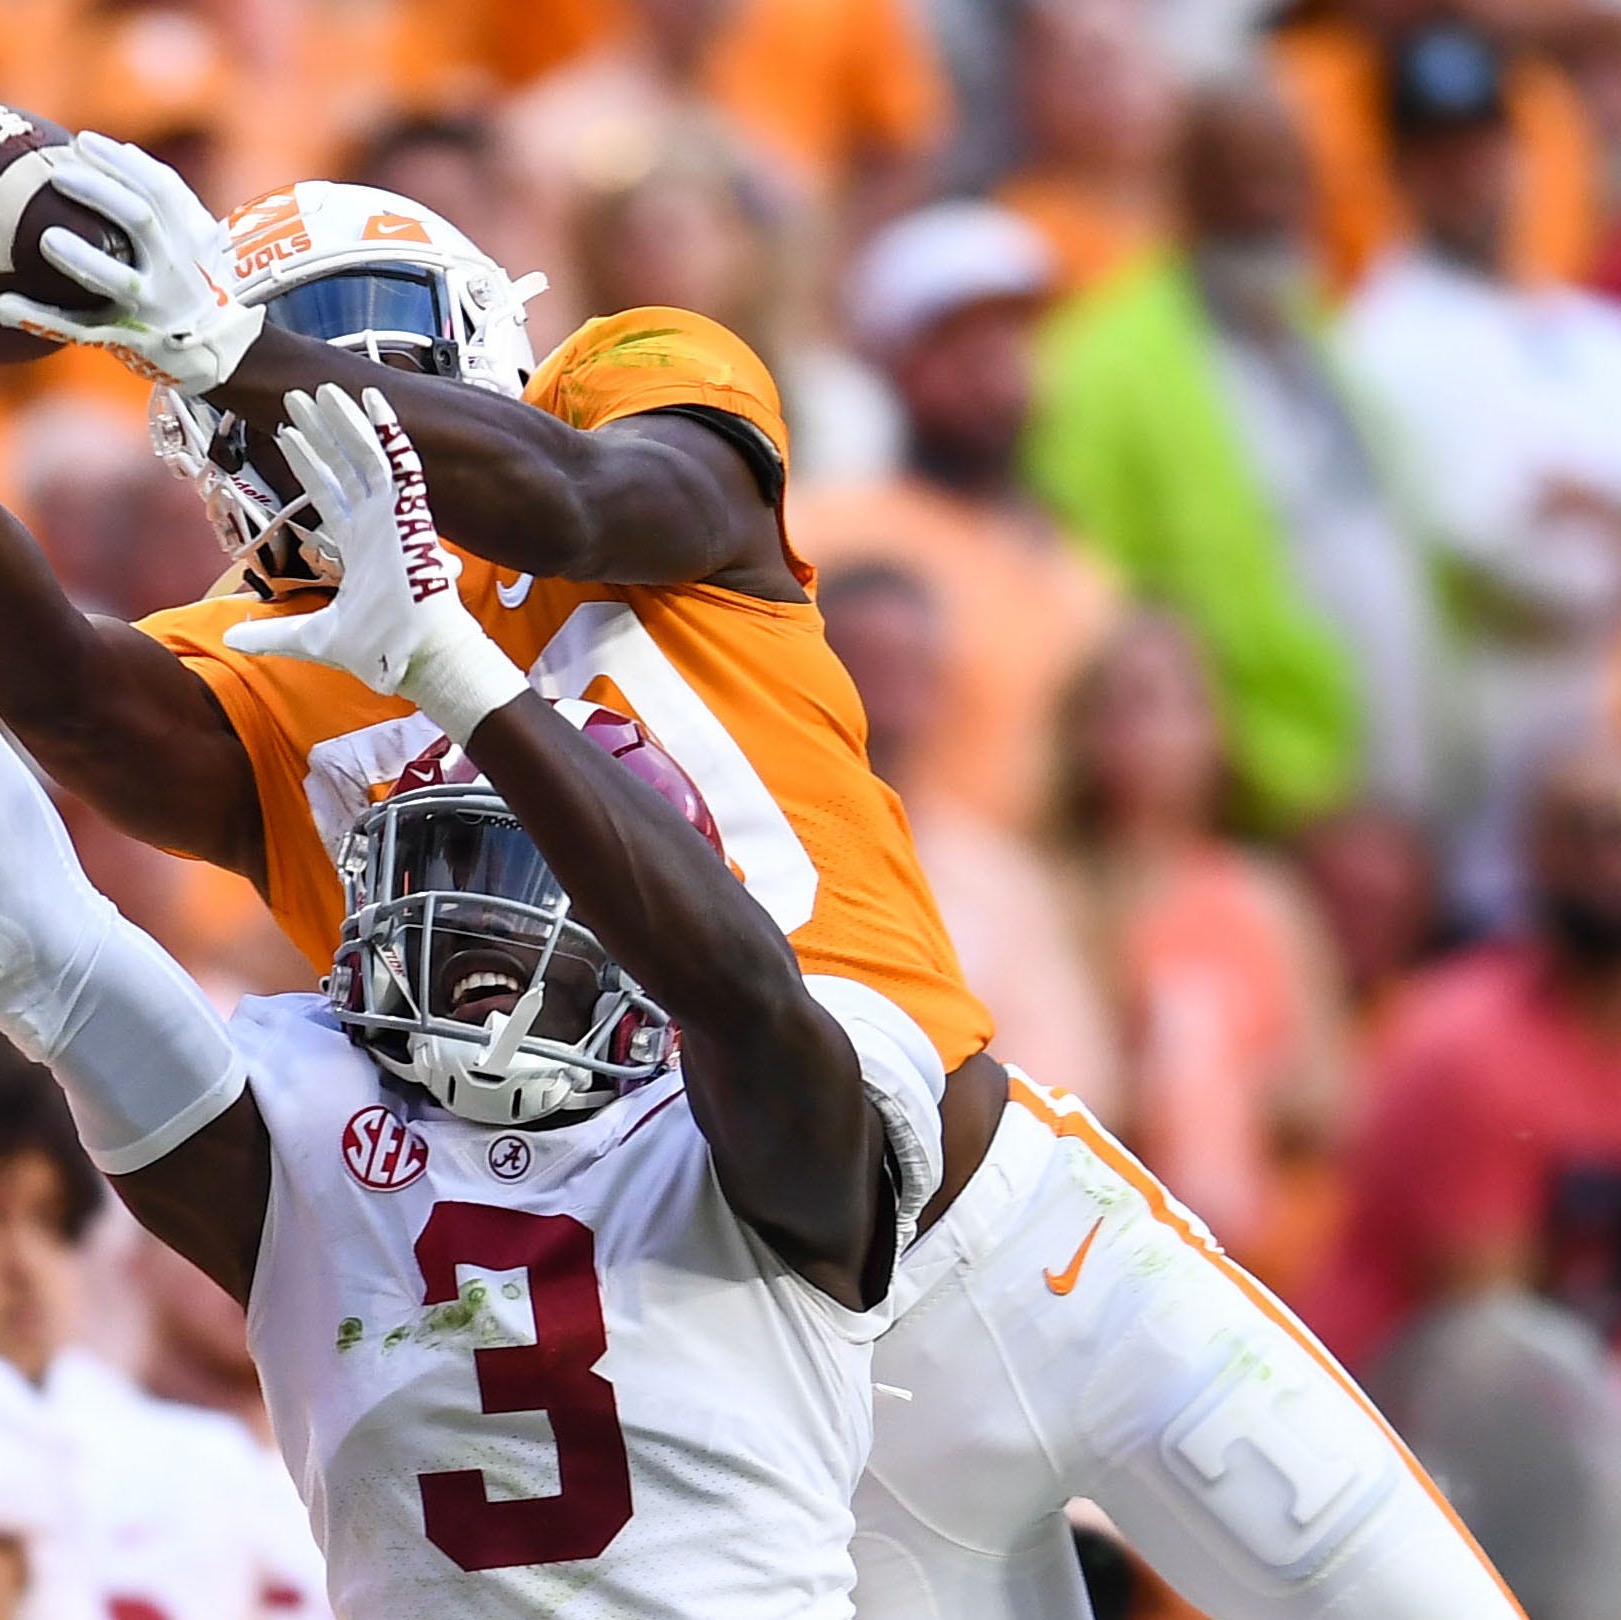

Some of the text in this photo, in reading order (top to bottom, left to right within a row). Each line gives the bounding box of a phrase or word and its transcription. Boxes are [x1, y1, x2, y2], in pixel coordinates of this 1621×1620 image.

[235, 233, 312, 279] VOLS
[375, 423, 450, 604] ALABAMA
[345, 1107, 424, 1185] SEC
[491, 1141, 524, 1171] A
[414, 1201, 634, 1573] 3
